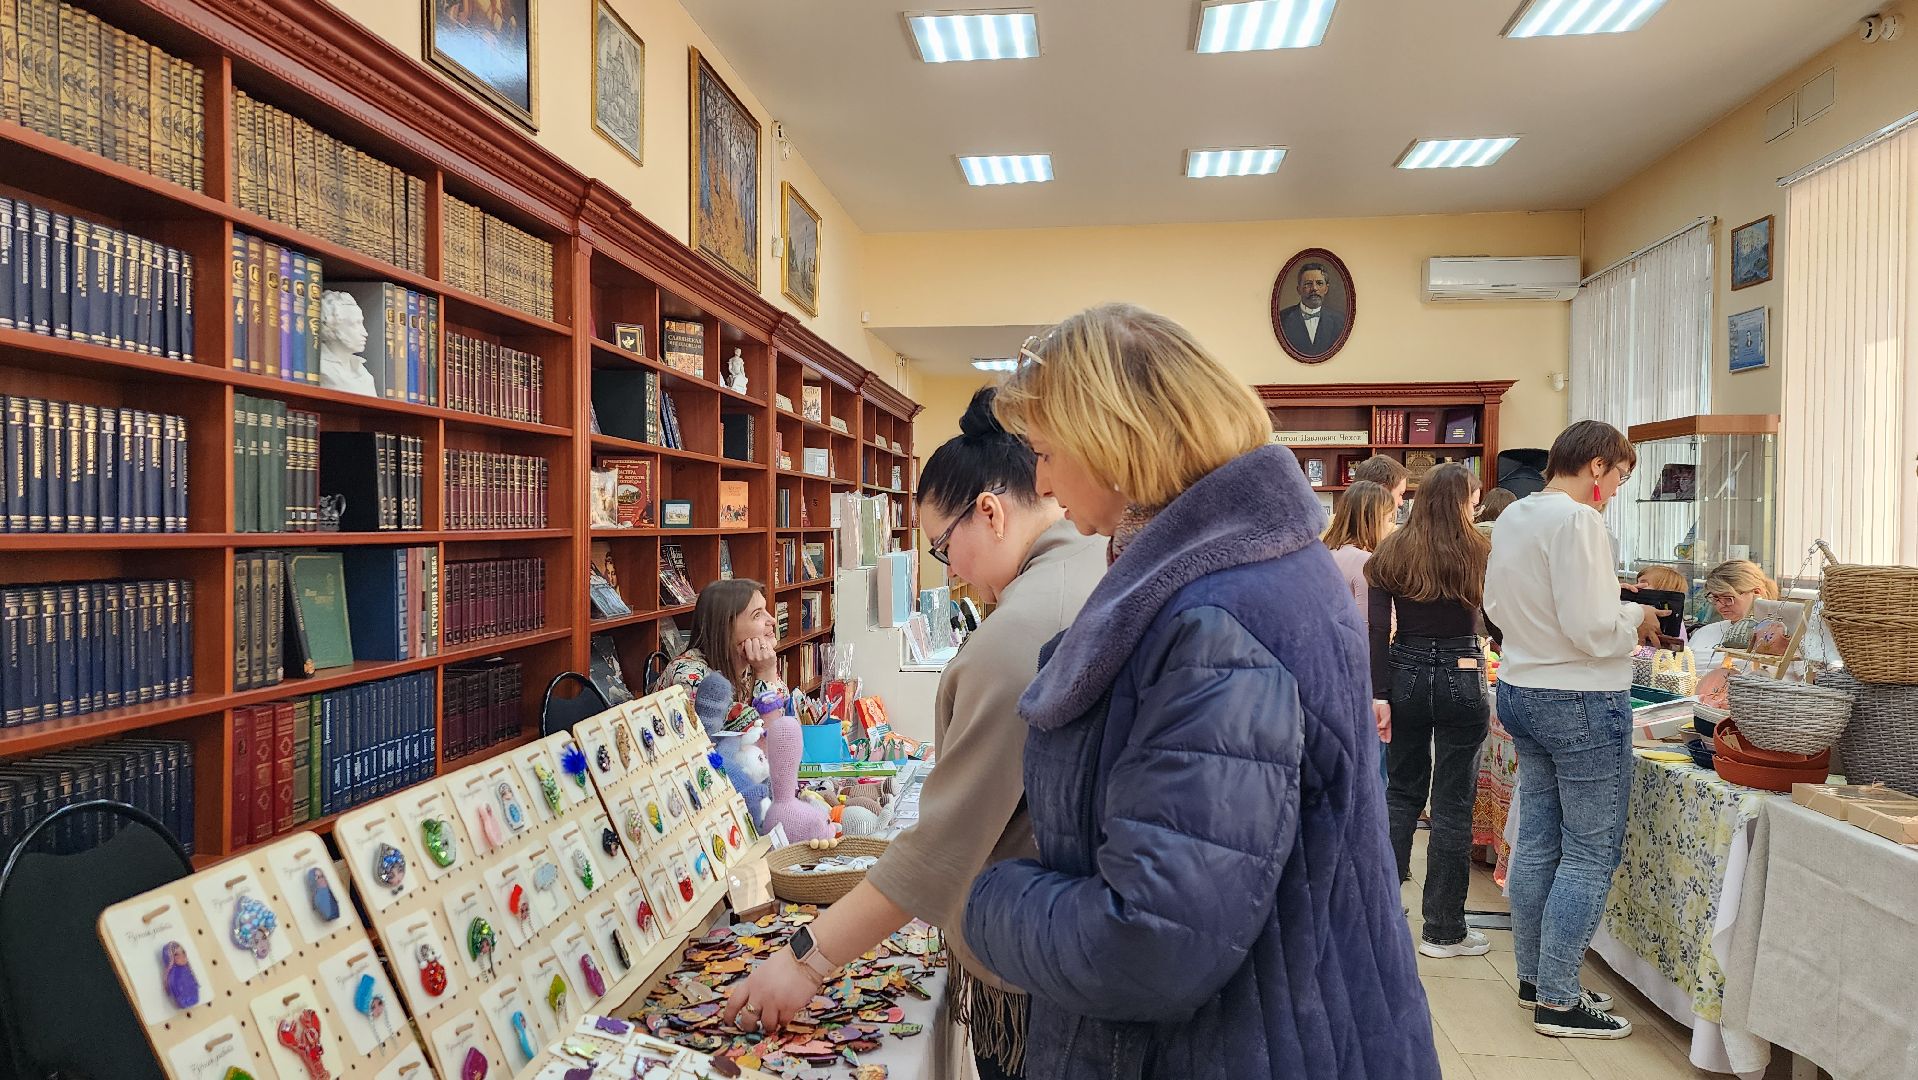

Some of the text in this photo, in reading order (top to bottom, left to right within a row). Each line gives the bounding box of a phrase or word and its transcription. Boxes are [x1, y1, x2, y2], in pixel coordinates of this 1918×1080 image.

[1275, 434, 1298, 442] Антон
[1301, 434, 1336, 442] Павлович
[431, 556, 439, 574] ВЕКА
[431, 592, 439, 636] ИСТОРИЯ
